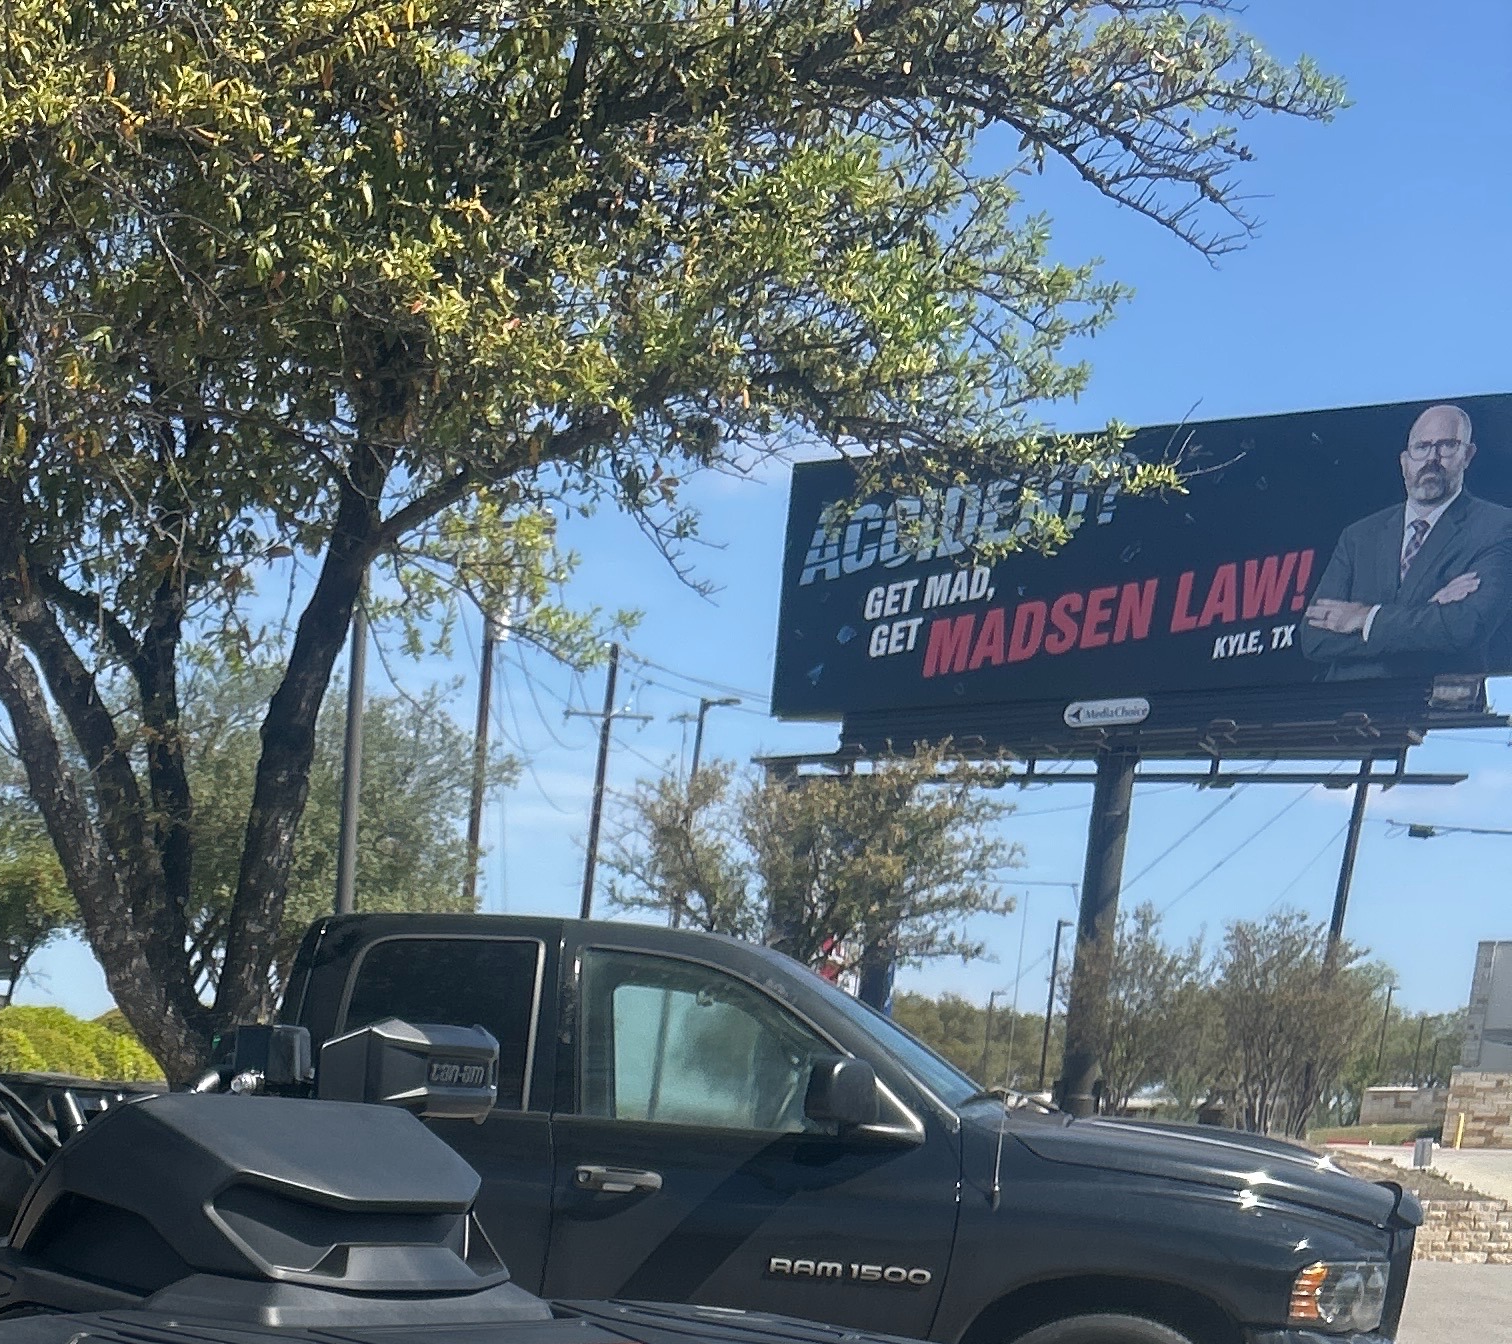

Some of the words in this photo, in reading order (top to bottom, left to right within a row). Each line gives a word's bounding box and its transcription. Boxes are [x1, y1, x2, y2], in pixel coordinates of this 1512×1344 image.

[863, 578, 919, 621] GET
[922, 566, 995, 610] MAD,
[868, 616, 924, 659] GET
[922, 578, 1159, 679] MADSEN
[1169, 549, 1315, 634] LAW!
[1211, 632, 1264, 661] KYLE,
[1270, 624, 1296, 650] TX
[430, 1063, 486, 1084] can-am
[769, 1257, 843, 1278] RAM
[849, 1263, 932, 1285] 1500
